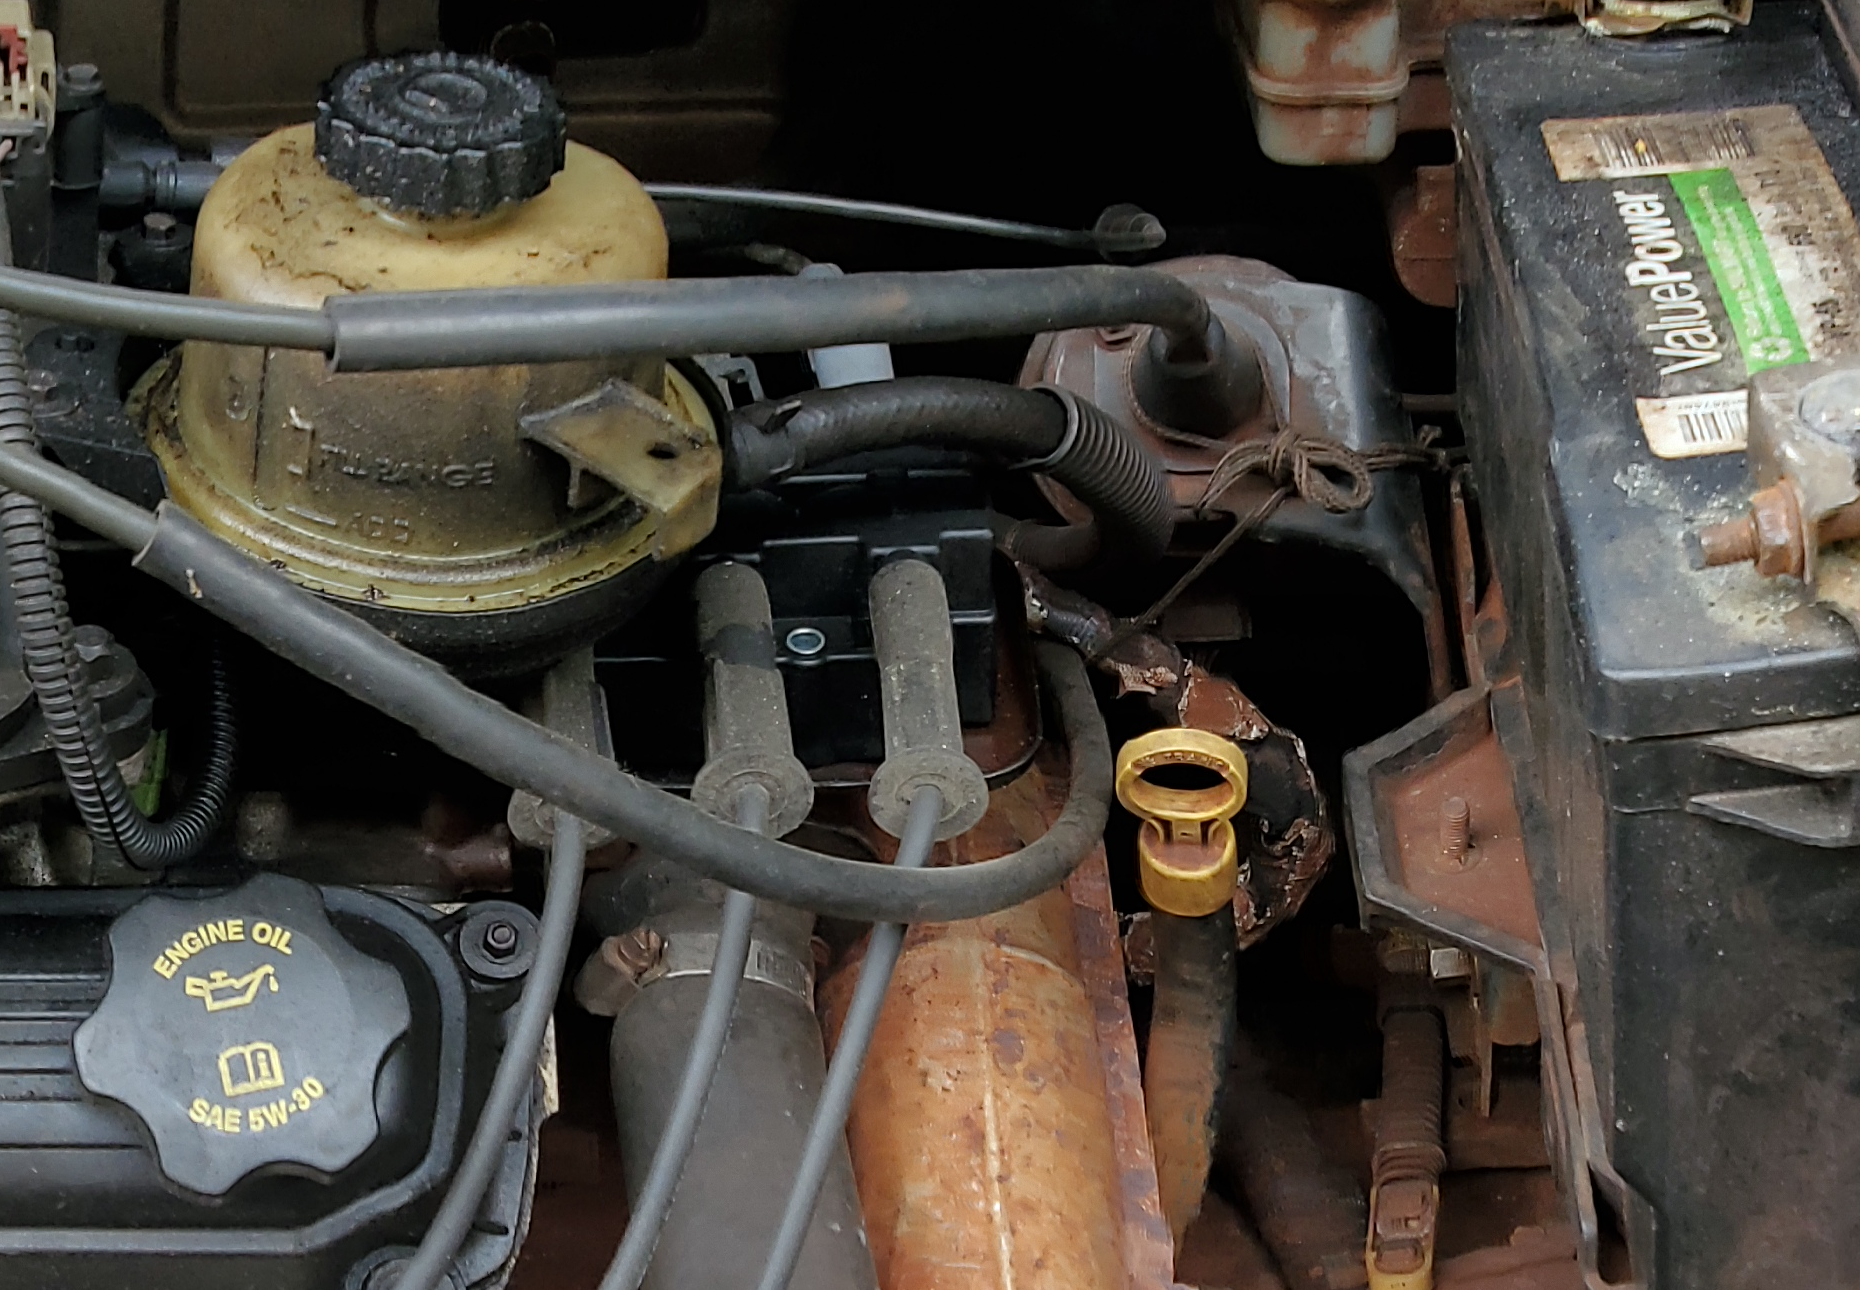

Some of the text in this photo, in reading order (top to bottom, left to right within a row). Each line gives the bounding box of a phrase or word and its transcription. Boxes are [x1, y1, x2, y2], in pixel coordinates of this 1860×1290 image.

[1613, 189, 1723, 376] ValuePower
[152, 918, 293, 980] ENGINE OIL
[188, 1075, 325, 1134] SAE 5W-30
